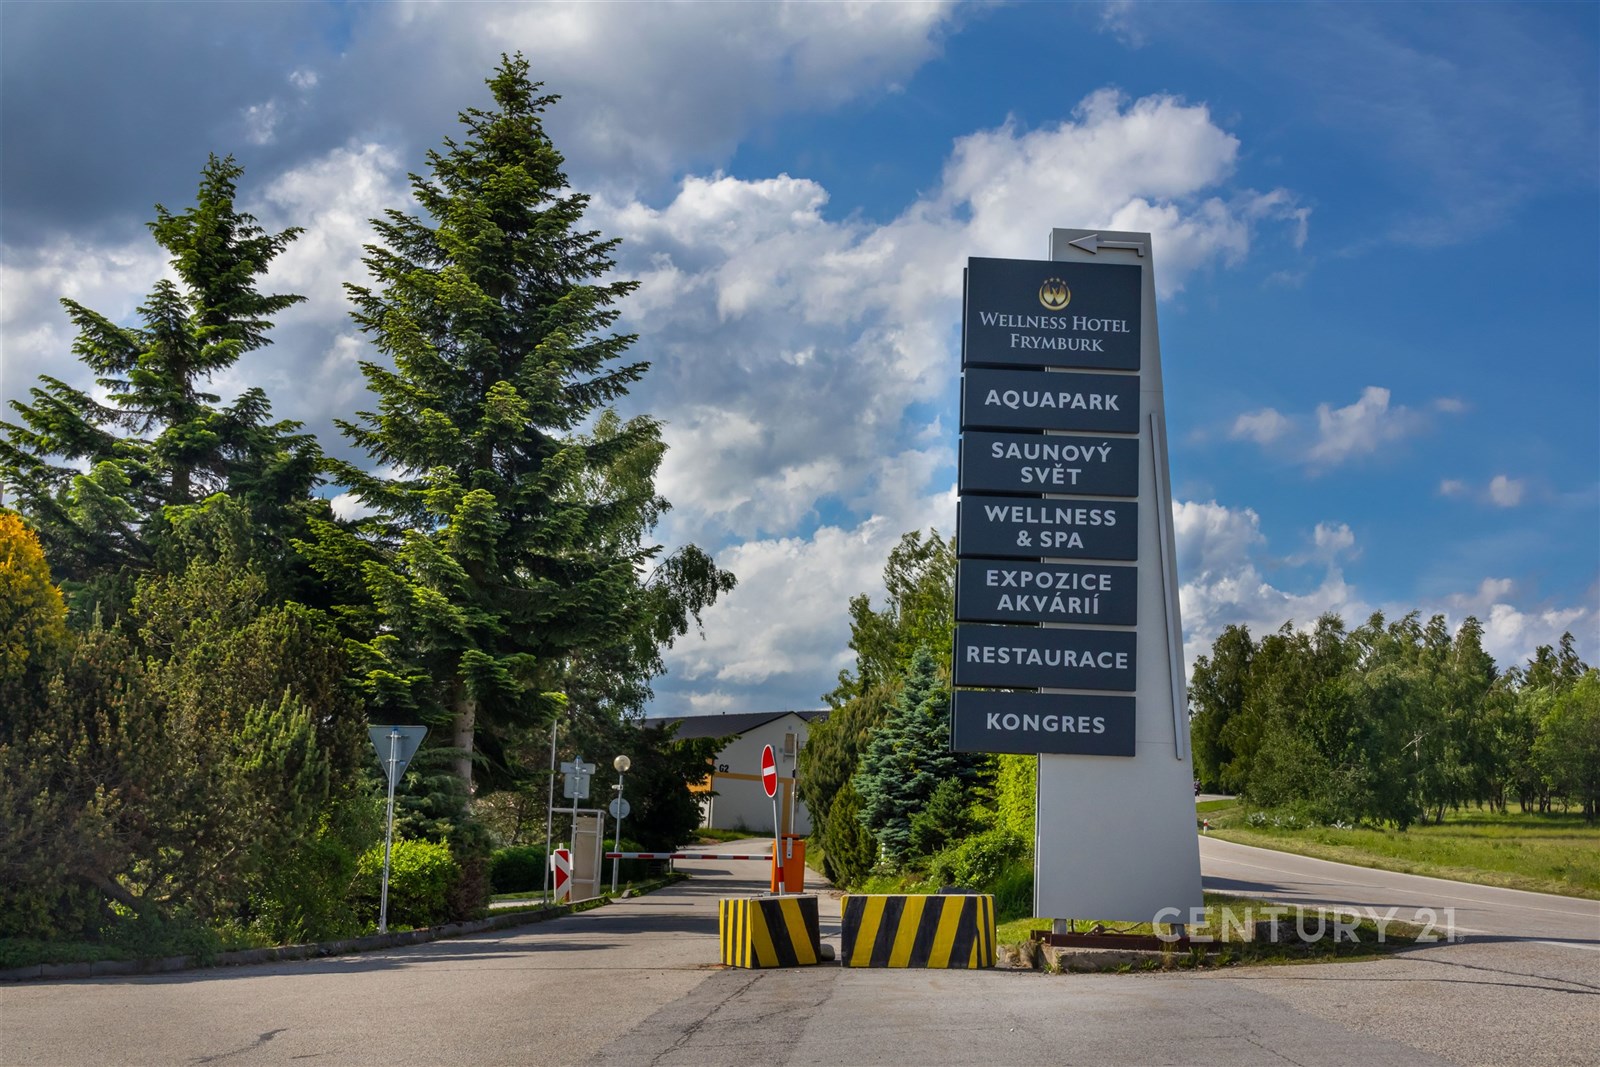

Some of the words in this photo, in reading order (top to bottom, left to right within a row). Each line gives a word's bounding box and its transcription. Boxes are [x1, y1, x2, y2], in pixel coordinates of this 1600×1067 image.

[984, 389, 1120, 411] AQUAPARK
[991, 442, 1112, 463] SAUNOVÝ
[1020, 463, 1082, 485] SVĚT
[984, 505, 1117, 527] WELLNESS
[1016, 530, 1032, 547] &
[1039, 531, 1084, 549] SPA
[986, 569, 1112, 592] EXPOZICE
[996, 592, 1101, 615] AKVÁRIÍ
[966, 645, 1128, 670] RESTAURACE
[986, 712, 1106, 734] KONGRES
